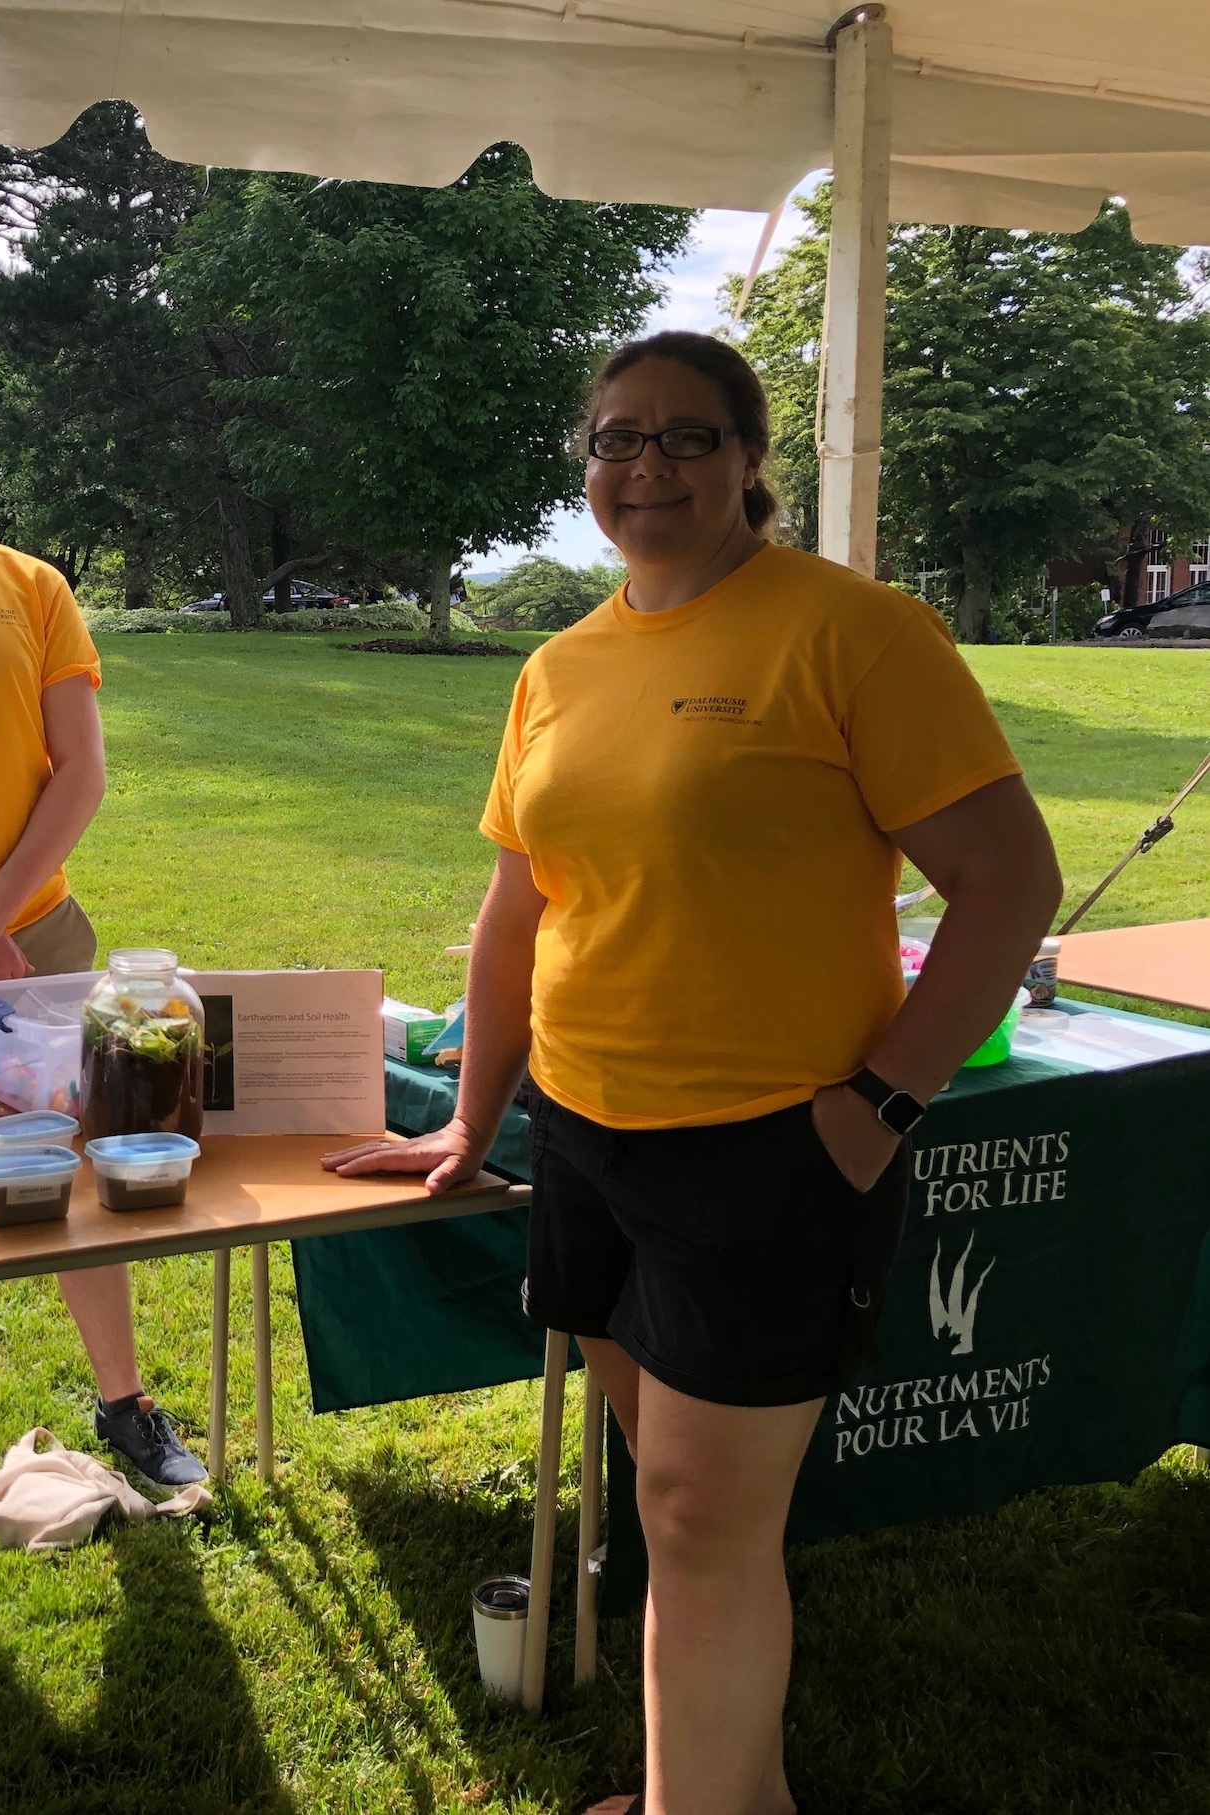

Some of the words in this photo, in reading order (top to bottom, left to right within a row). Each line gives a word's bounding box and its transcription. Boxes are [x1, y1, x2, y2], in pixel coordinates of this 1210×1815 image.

[686, 705, 746, 715] UNIVERSITY
[689, 697, 748, 706] DALHOUSIE
[237, 1013, 287, 1023] Earthworms
[289, 1013, 305, 1021] and
[306, 1012, 321, 1021] Soil
[323, 1012, 350, 1021] Health
[913, 1130, 1071, 1181] UTRIENTS
[923, 1179, 993, 1217] FOR
[1000, 1169, 1067, 1207] LIFE
[835, 1353, 1051, 1425] NUTRIMENTS
[835, 1414, 930, 1464] POUR
[938, 1408, 981, 1442] LA
[988, 1395, 1031, 1434] VIE
